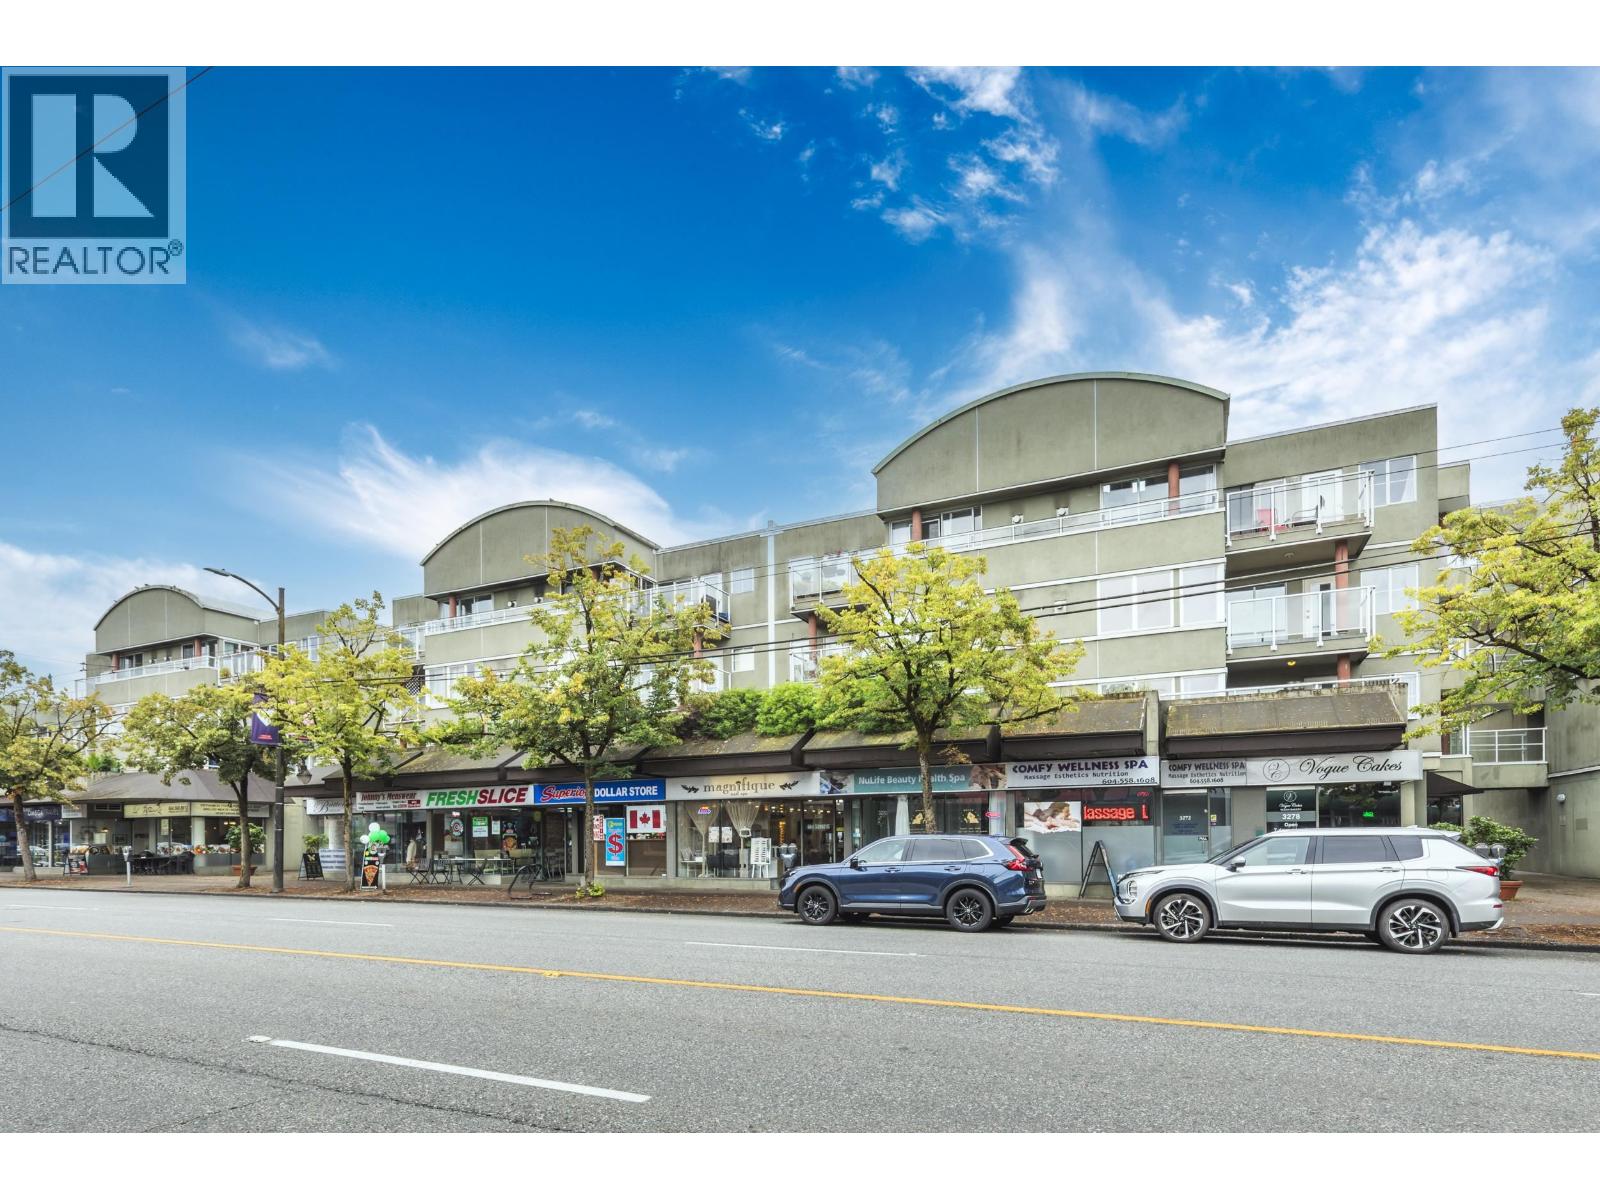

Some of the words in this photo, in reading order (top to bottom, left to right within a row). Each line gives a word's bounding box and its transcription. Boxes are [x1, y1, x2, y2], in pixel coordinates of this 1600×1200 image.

[1012, 763, 1052, 773] COMFY
[1058, 760, 1119, 772] WELLNESS
[1124, 760, 1148, 769] SPA
[1168, 763, 1192, 772] COMFY
[1194, 762, 1229, 770] WELLNESS
[1232, 761, 1246, 769] SPA
[1300, 756, 1349, 780] Vogue
[1352, 755, 1402, 772] Cakes
[703, 777, 775, 794] magnifique
[858, 775, 885, 785] NuLife
[887, 775, 916, 786] Beauty
[949, 774, 966, 784] Spa
[541, 785, 588, 802] Superio
[594, 787, 628, 797] DOLLAR
[629, 785, 658, 796] STORE
[1083, 805, 1135, 820] assage
